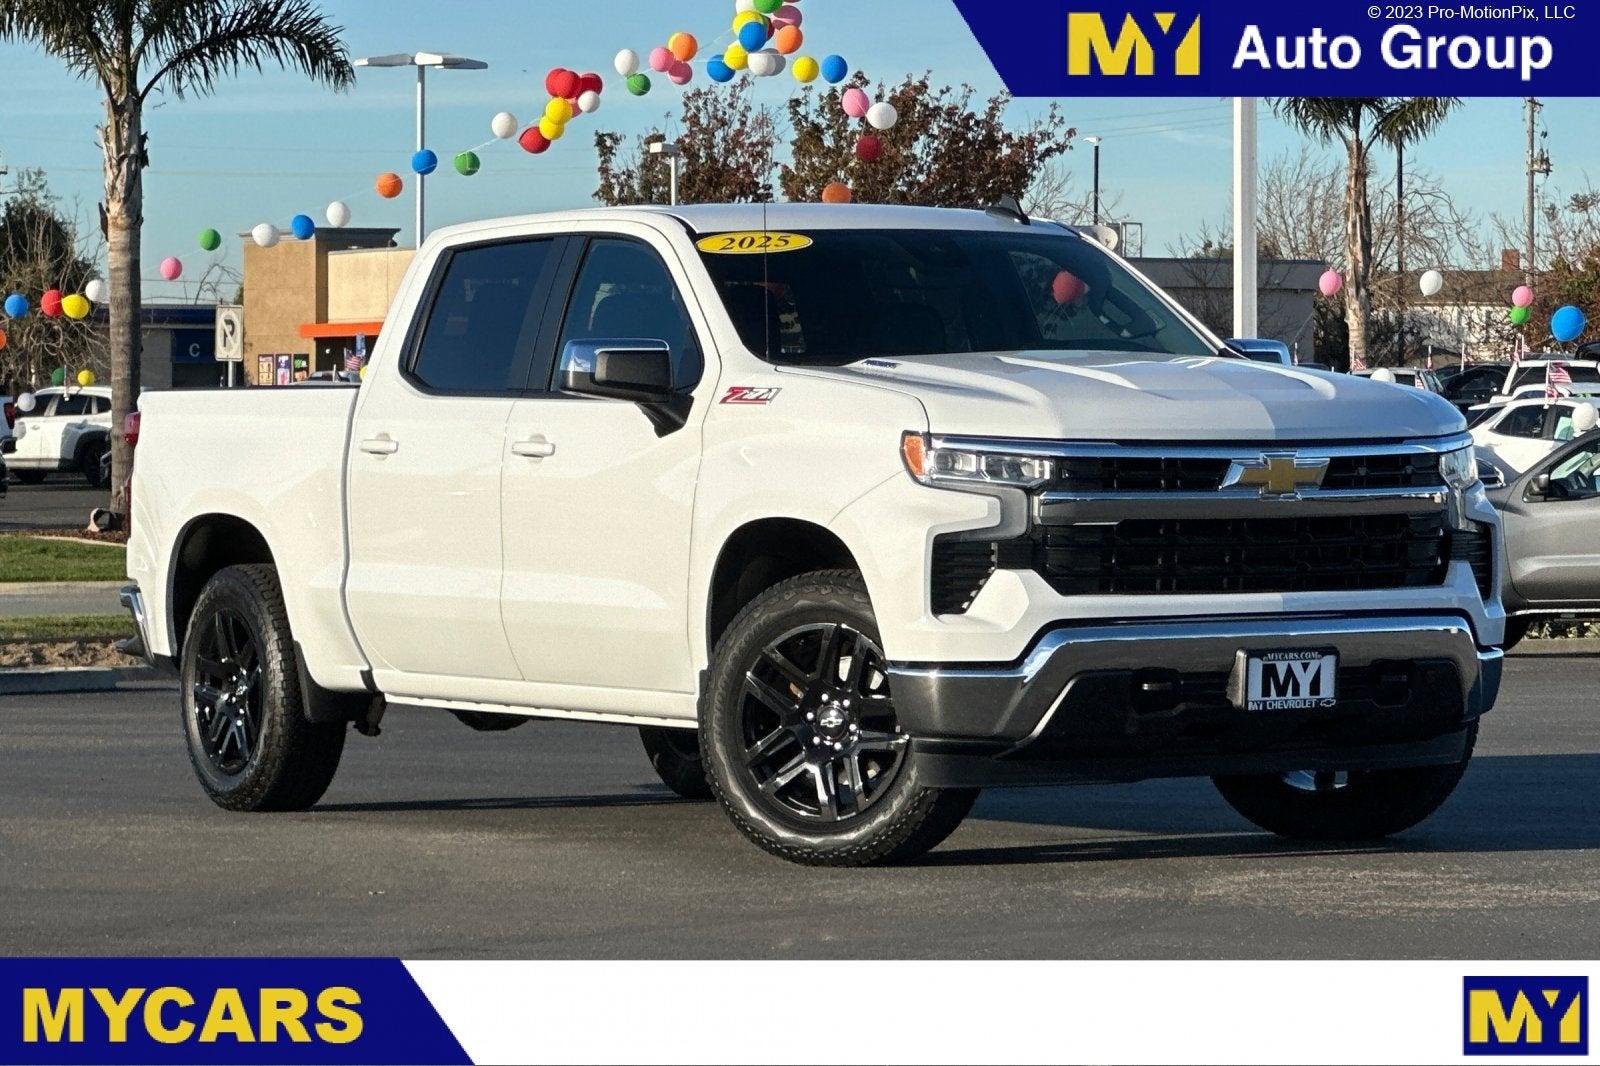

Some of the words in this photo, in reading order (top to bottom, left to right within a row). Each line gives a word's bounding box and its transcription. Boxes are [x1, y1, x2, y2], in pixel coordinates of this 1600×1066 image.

[719, 235, 791, 251] 2025
[1267, 652, 1318, 660] MYCARS.COM
[1261, 661, 1321, 698] MY
[1266, 699, 1317, 710] CHEVROLET
